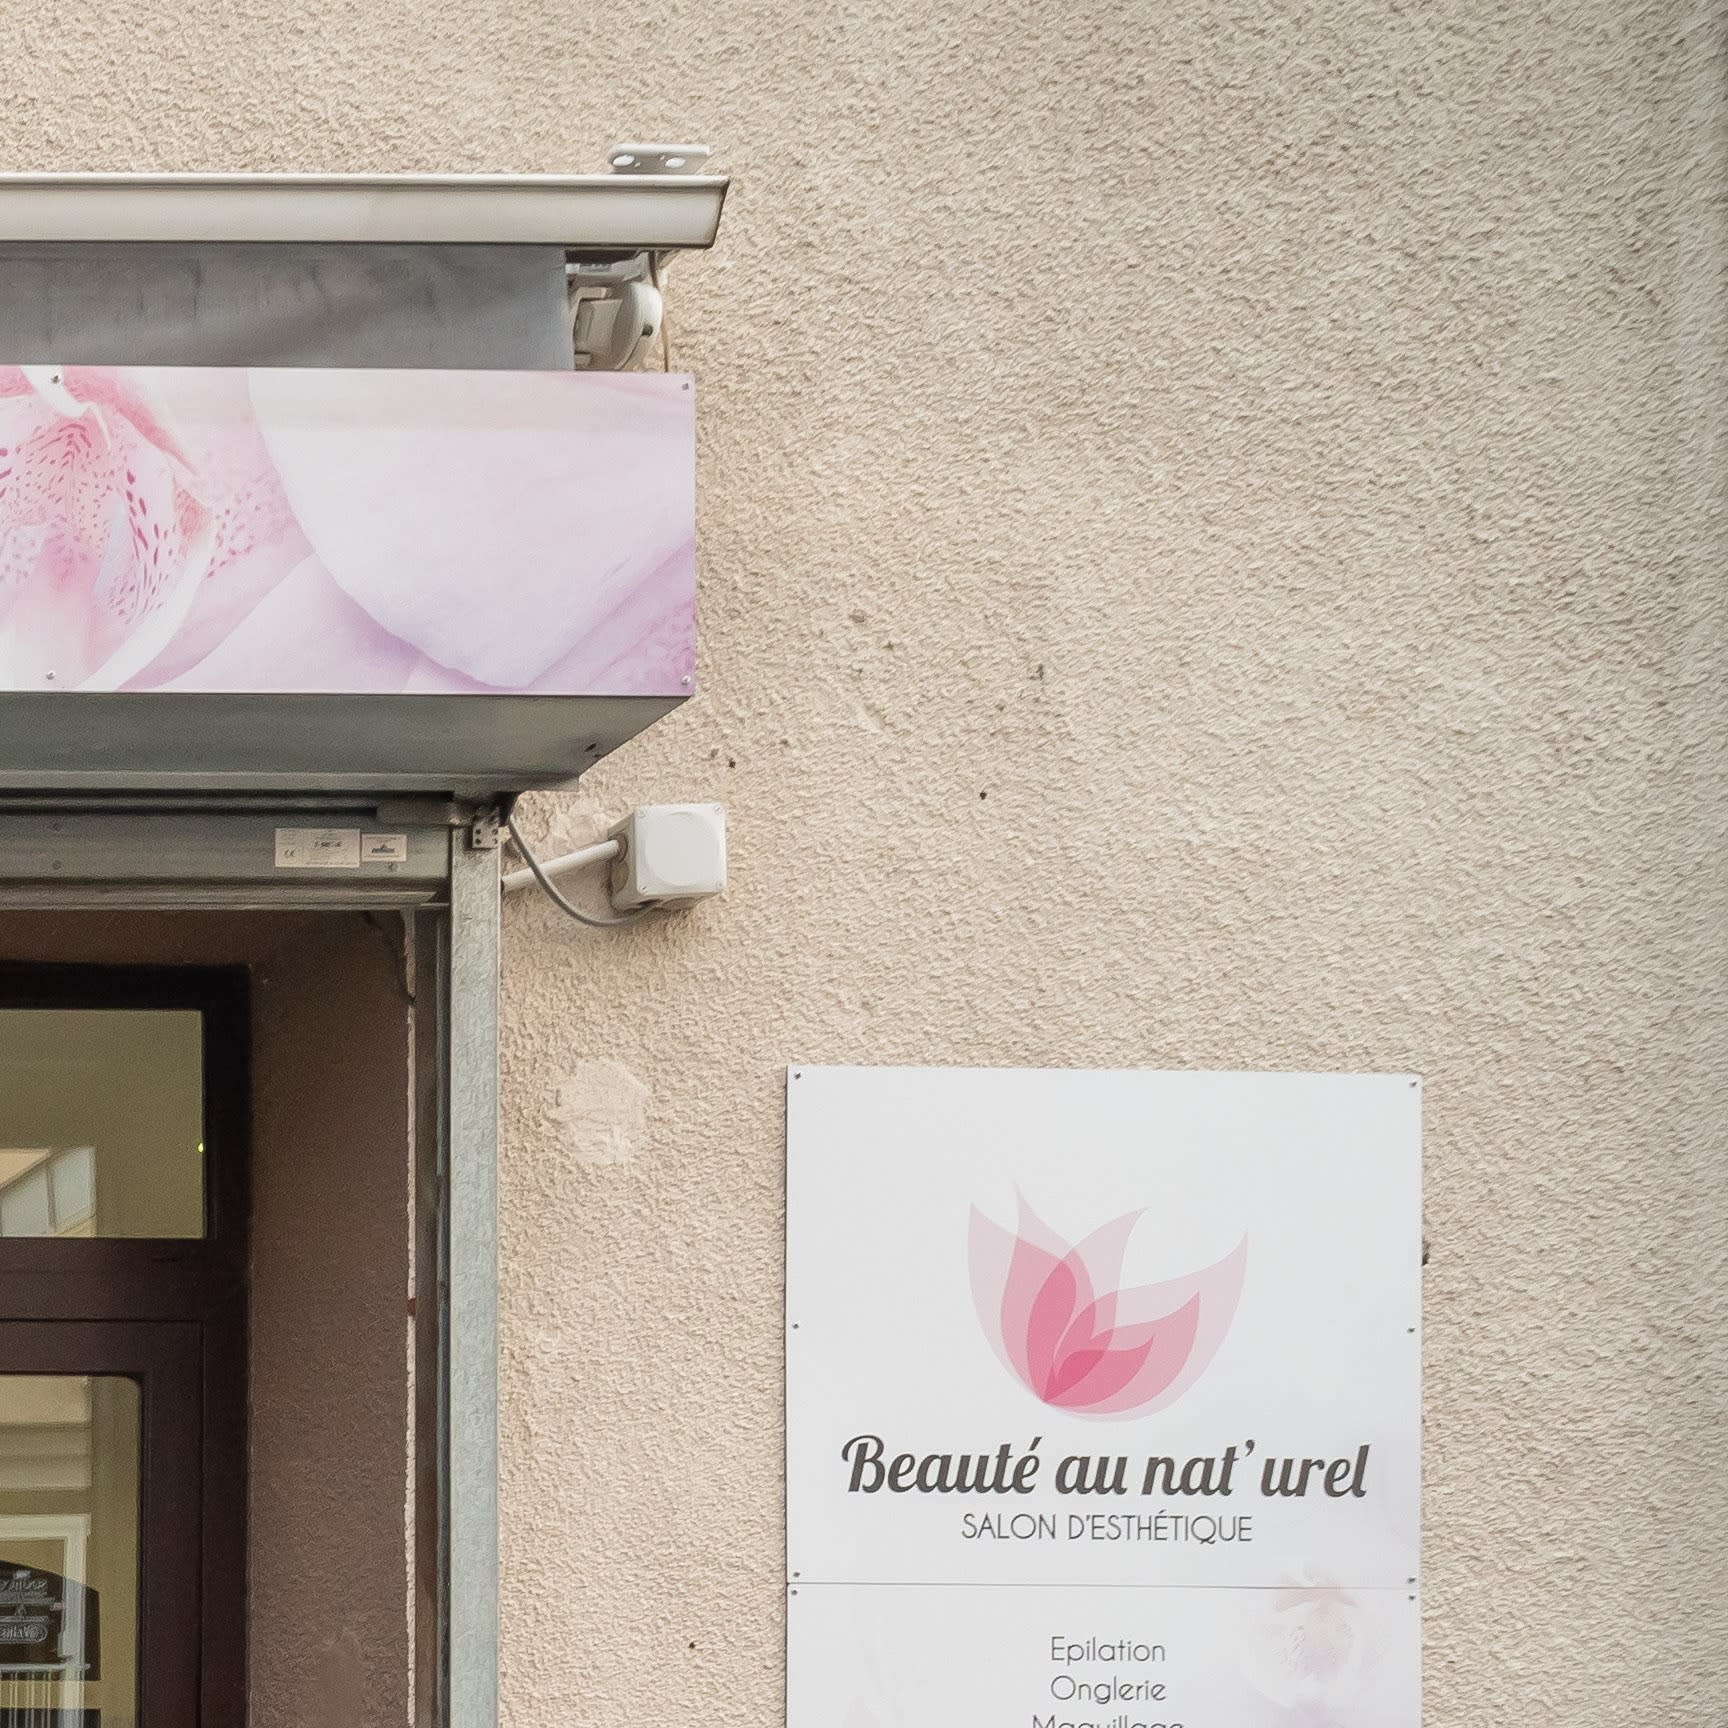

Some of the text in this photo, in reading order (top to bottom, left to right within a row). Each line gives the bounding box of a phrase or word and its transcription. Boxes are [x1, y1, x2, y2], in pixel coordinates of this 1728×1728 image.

[842, 1435, 1370, 1498] Beauté au nat'urel
[962, 1510, 1252, 1544] SALON D'ESTHÉTIQUE
[1052, 1636, 1165, 1665] Epilation
[1051, 1676, 1166, 1704] Onglerie
